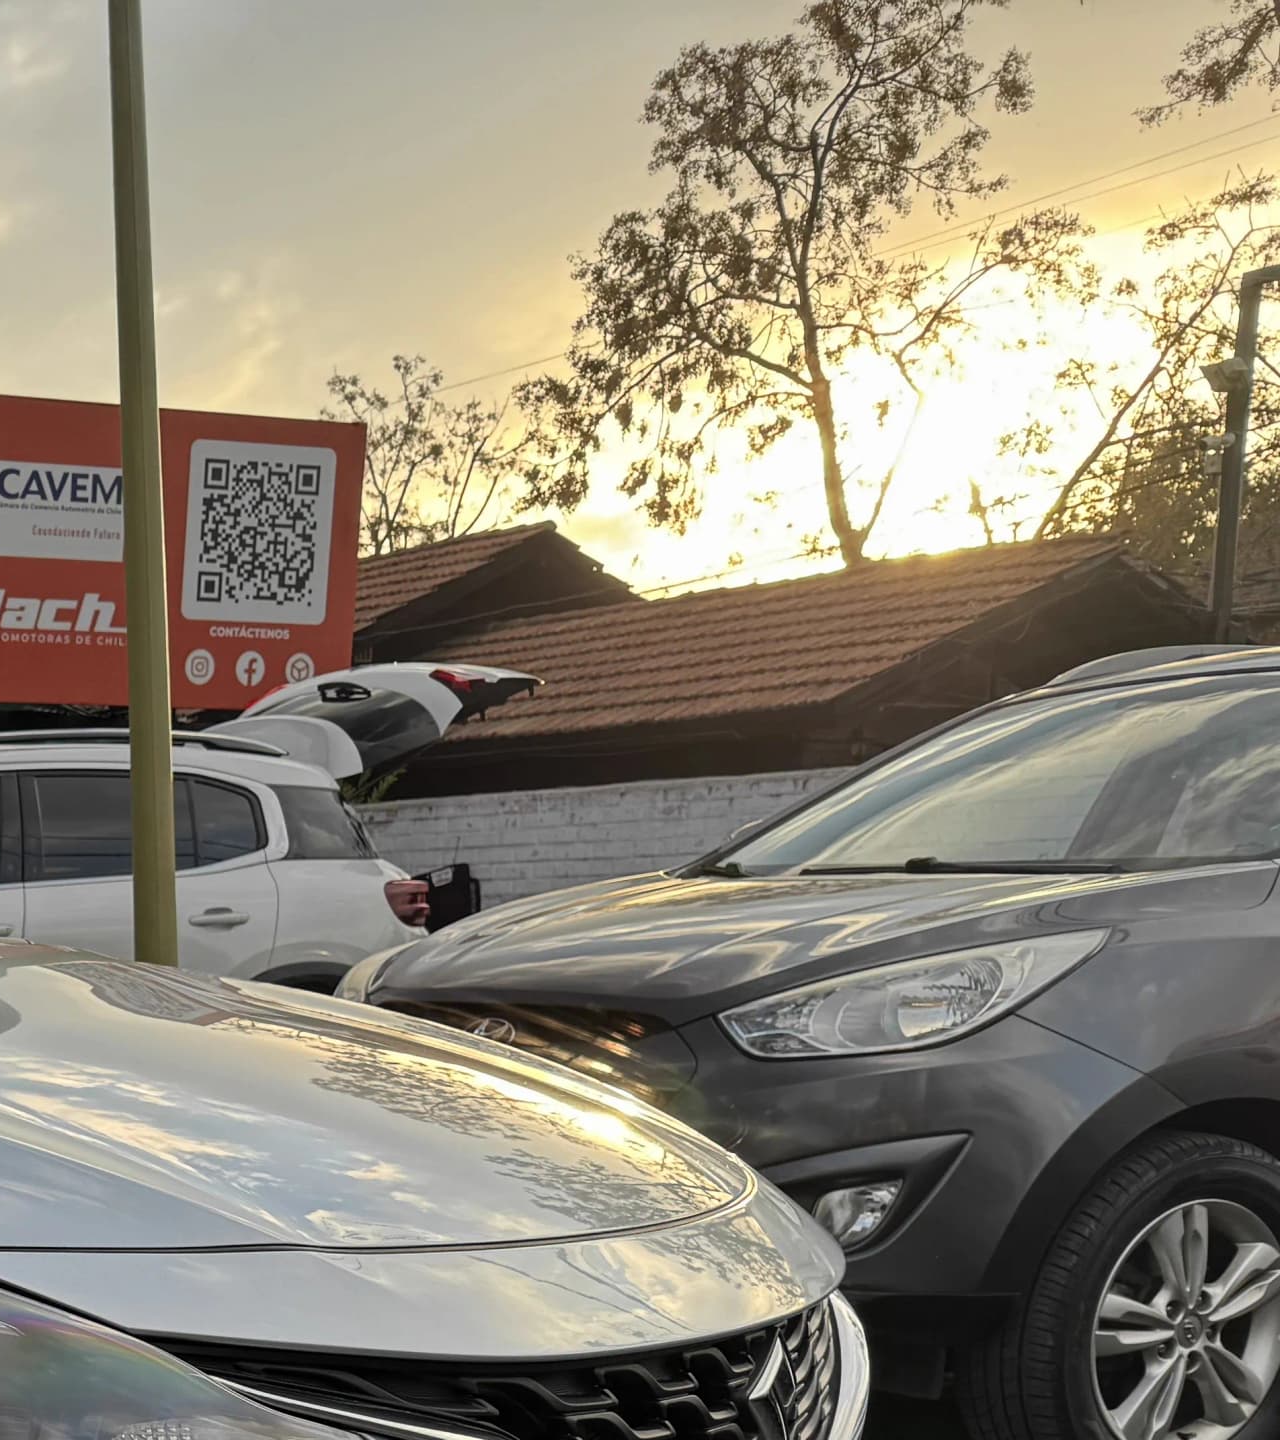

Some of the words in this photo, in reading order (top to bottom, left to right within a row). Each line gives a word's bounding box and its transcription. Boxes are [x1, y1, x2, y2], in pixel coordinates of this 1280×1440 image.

[208, 624, 291, 640] CONTÁCTENOS
[75, 635, 92, 646] DE
[96, 636, 127, 648] CHIL
